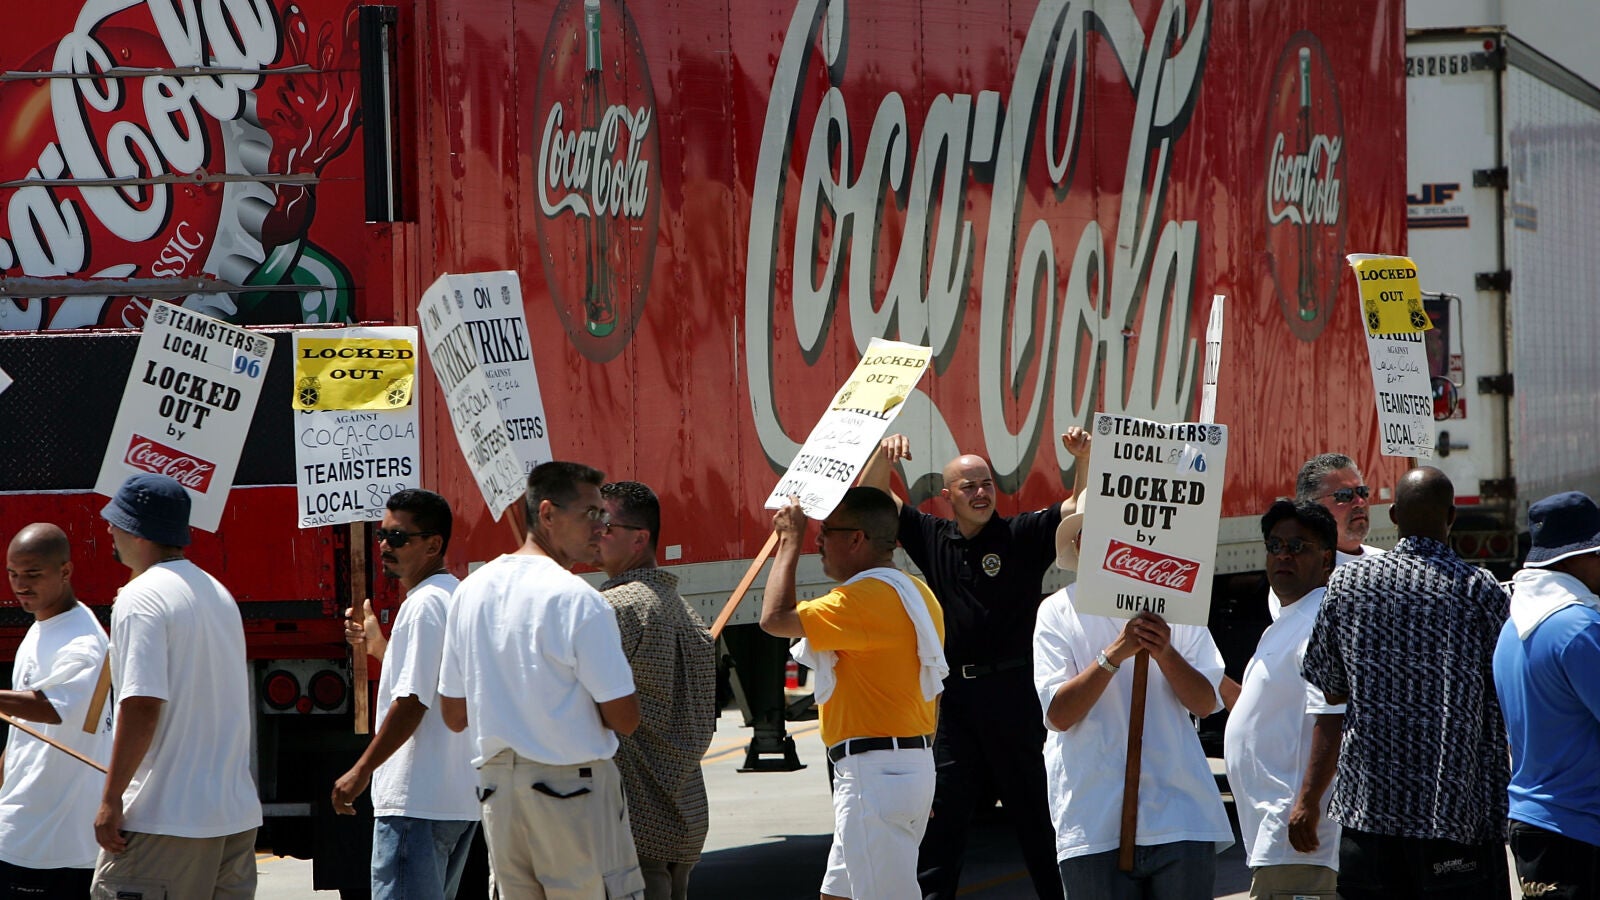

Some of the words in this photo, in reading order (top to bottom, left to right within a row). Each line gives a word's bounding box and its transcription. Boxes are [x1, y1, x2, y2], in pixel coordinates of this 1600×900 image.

[1407, 55, 1469, 76] 292658
[538, 102, 651, 217] Coca-Cola
[1267, 132, 1342, 224] Coca-Cola
[1360, 268, 1417, 281] LOCKED
[473, 287, 491, 309] ON
[1380, 291, 1404, 302] OUT
[428, 304, 442, 331] ON
[168, 309, 255, 352] TEAMSTERS
[465, 317, 529, 365] TRIKE
[162, 333, 209, 363] LOCAL
[235, 355, 260, 379] 96
[303, 347, 414, 360] LOCKED
[431, 323, 477, 398] STRIKE
[864, 356, 925, 368] LOCKED
[142, 360, 241, 412] LOCKED
[330, 368, 384, 380] OUT
[866, 374, 898, 385] OUT
[159, 394, 211, 429] OUT
[1379, 392, 1431, 417] TEAMSTERS
[335, 413, 379, 425] AGAINST
[1114, 417, 1207, 442] TEAMSTERS
[166, 423, 186, 441] by
[301, 422, 416, 448] COCA-COLA
[1384, 422, 1415, 445] LOCAL
[127, 441, 215, 488] Coca-Cola
[1114, 442, 1164, 463] LOCAL
[304, 456, 412, 485] TEAMSTERS
[793, 454, 855, 483] TEAMSTERS
[1100, 472, 1205, 506] LOCKED
[306, 490, 364, 515] LOCAL
[1123, 502, 1177, 530] OUT
[1136, 529, 1156, 546] by
[1105, 546, 1198, 590] Coca-Cola
[1116, 594, 1166, 614] UNFAIR
